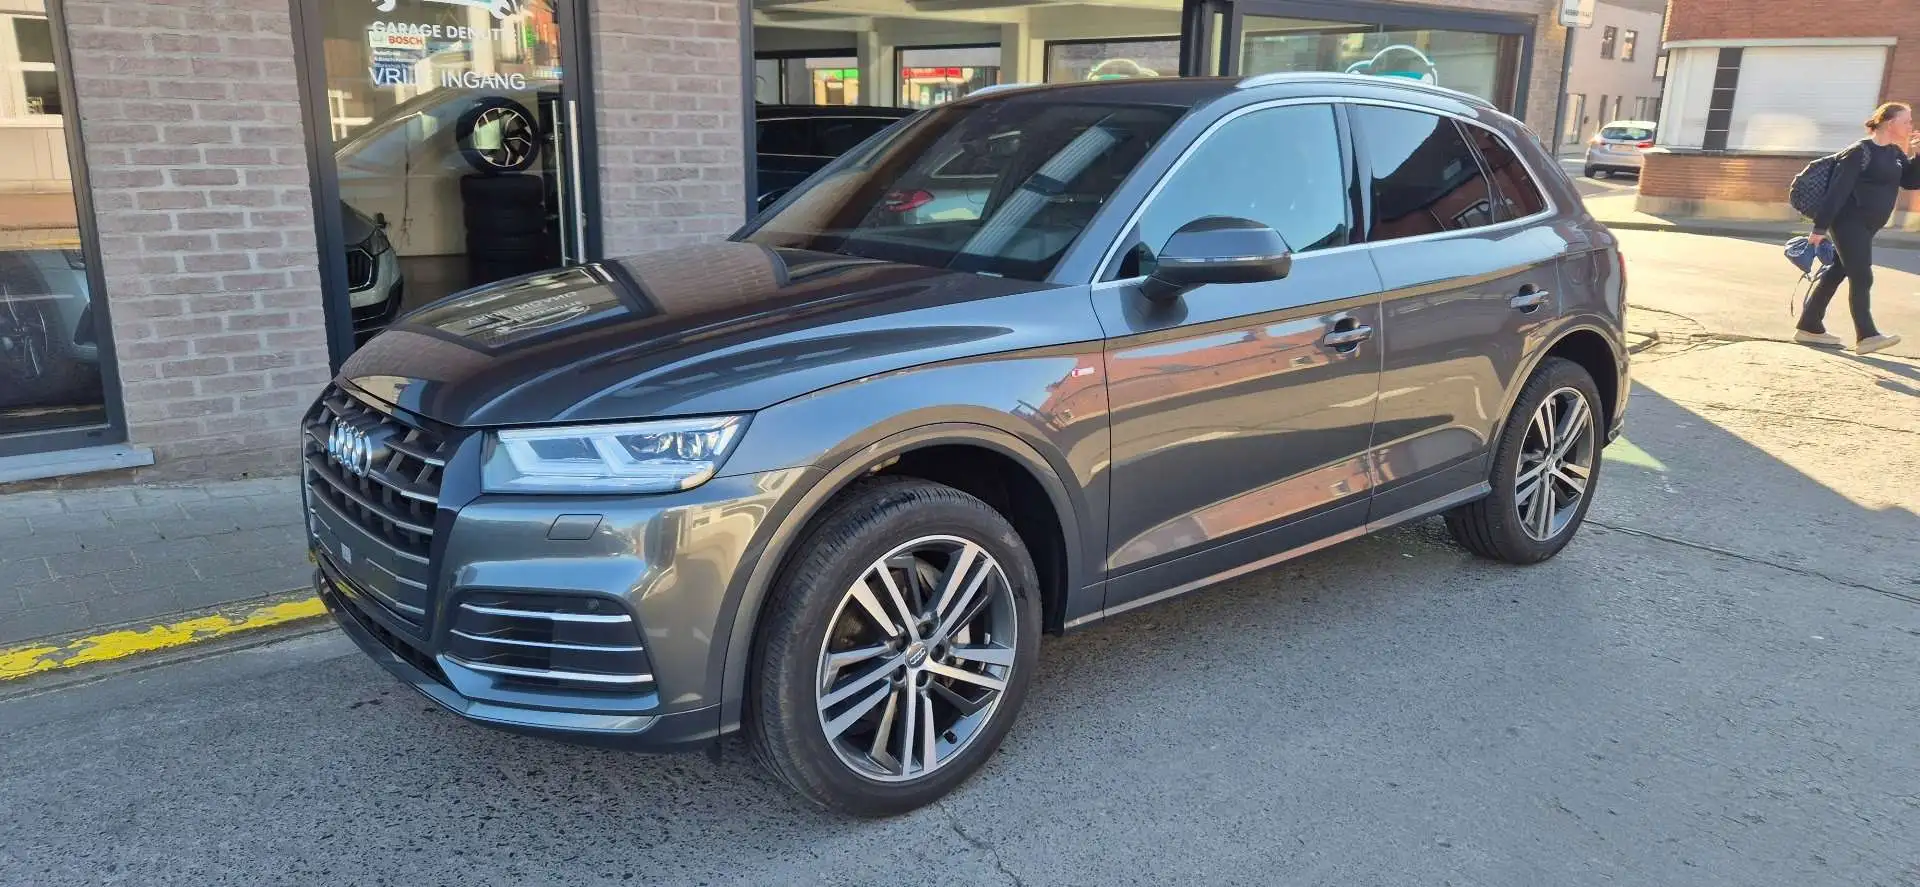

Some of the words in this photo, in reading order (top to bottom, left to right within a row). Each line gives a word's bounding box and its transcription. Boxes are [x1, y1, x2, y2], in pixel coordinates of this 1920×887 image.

[372, 20, 442, 38] GARAGE
[388, 35, 423, 45] BOSCH
[441, 70, 526, 90] INGANG
